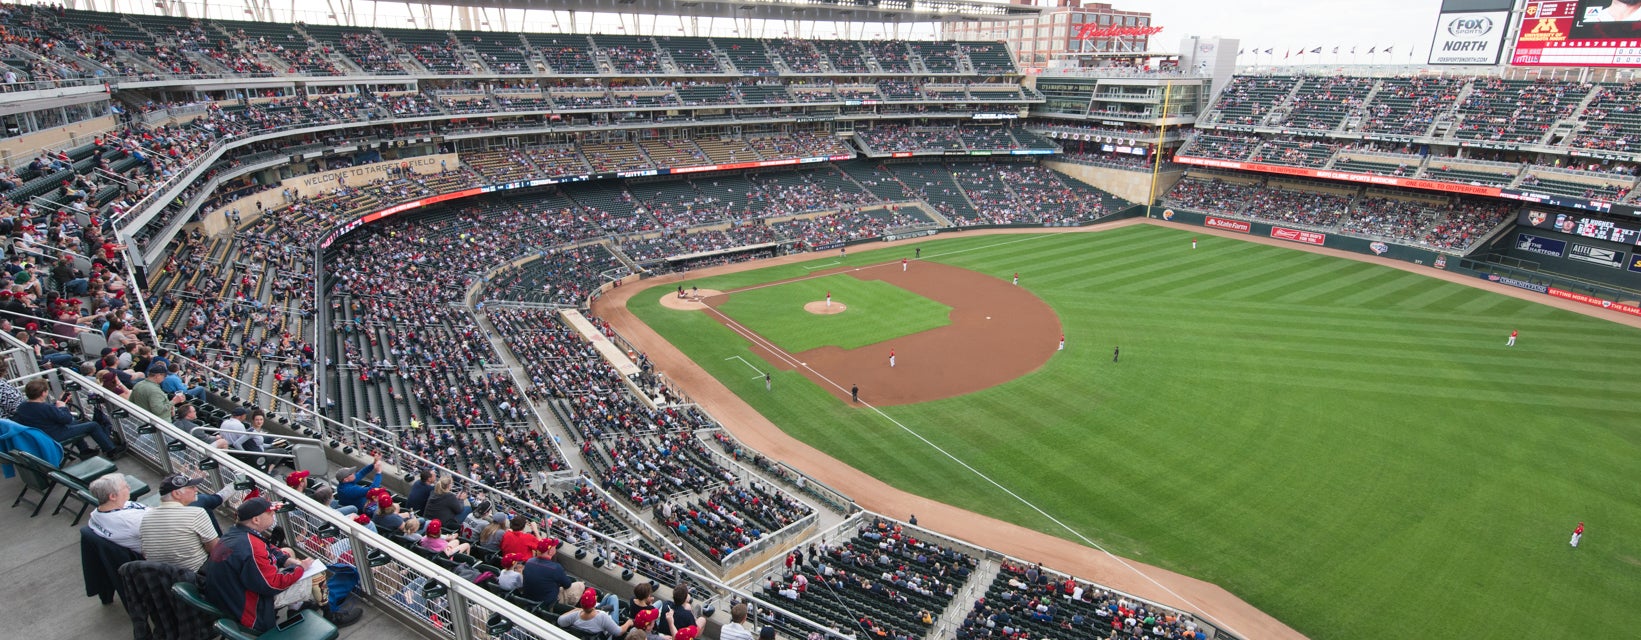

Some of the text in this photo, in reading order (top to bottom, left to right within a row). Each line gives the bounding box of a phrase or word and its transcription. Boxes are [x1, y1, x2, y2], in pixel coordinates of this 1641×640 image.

[1456, 20, 1484, 30] FOX
[1072, 22, 1164, 41] Budweiser
[1442, 40, 1488, 51] NORTH
[304, 158, 435, 186] WELCOME TO TARGET FIELD
[1332, 172, 1349, 180] CLINIC
[1350, 174, 1371, 182] SPORTS
[1371, 176, 1397, 185] MEDICINE
[1446, 184, 1488, 194] OUTPERFORM.
[1217, 219, 1247, 230] State Farm
[1529, 247, 1560, 256] HARTFORD
[1500, 276, 1530, 290] COMMUNITY
[1572, 294, 1588, 302] MORE
[1588, 297, 1601, 305] KIDS
